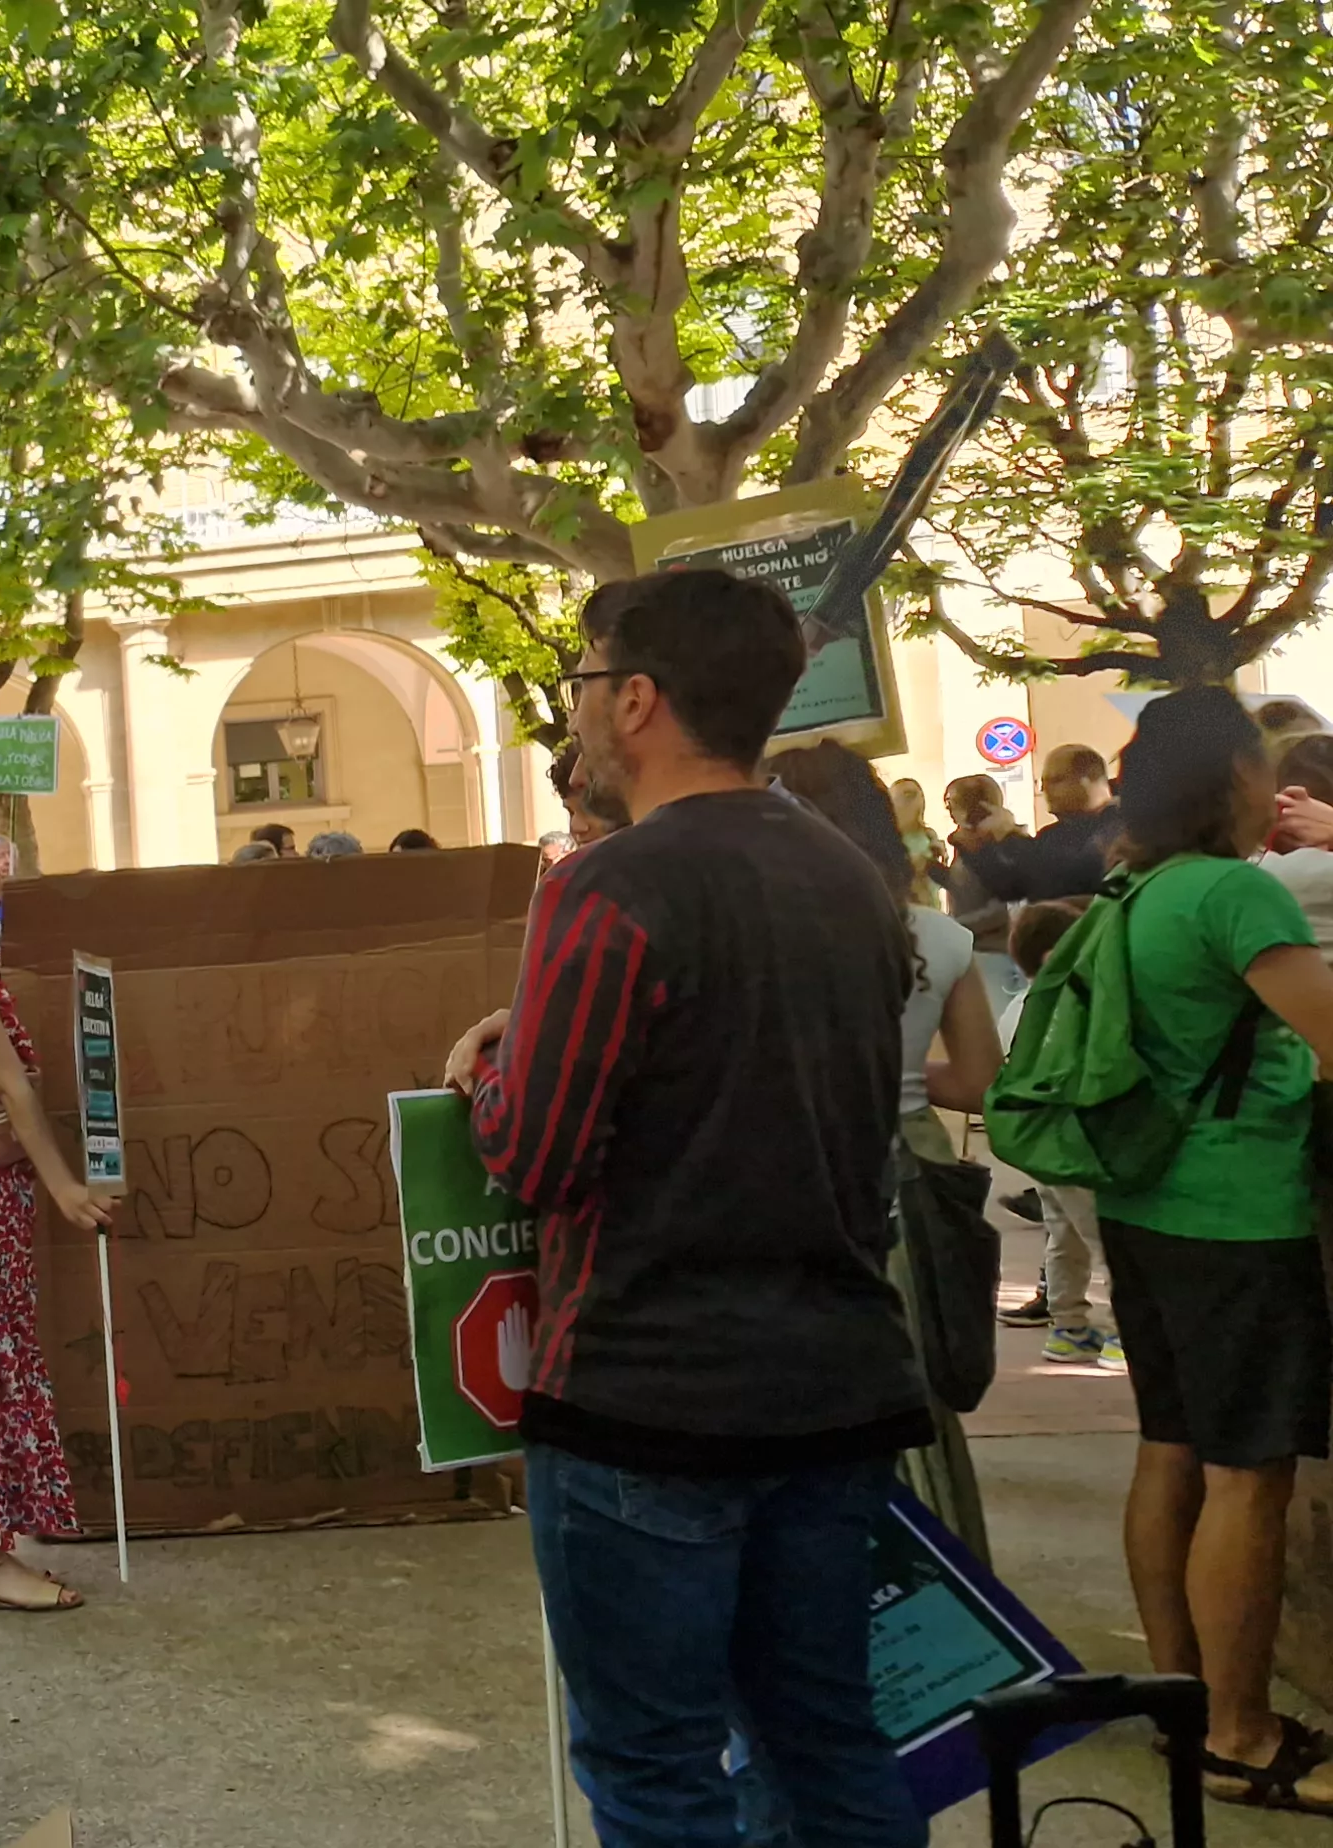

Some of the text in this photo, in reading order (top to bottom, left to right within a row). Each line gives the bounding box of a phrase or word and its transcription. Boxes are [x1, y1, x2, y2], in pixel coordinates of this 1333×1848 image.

[722, 539, 788, 563] HUELGA
[115, 1127, 272, 1240] NO
[411, 1220, 536, 1266] CONCIE
[138, 1257, 412, 1385] VEND
